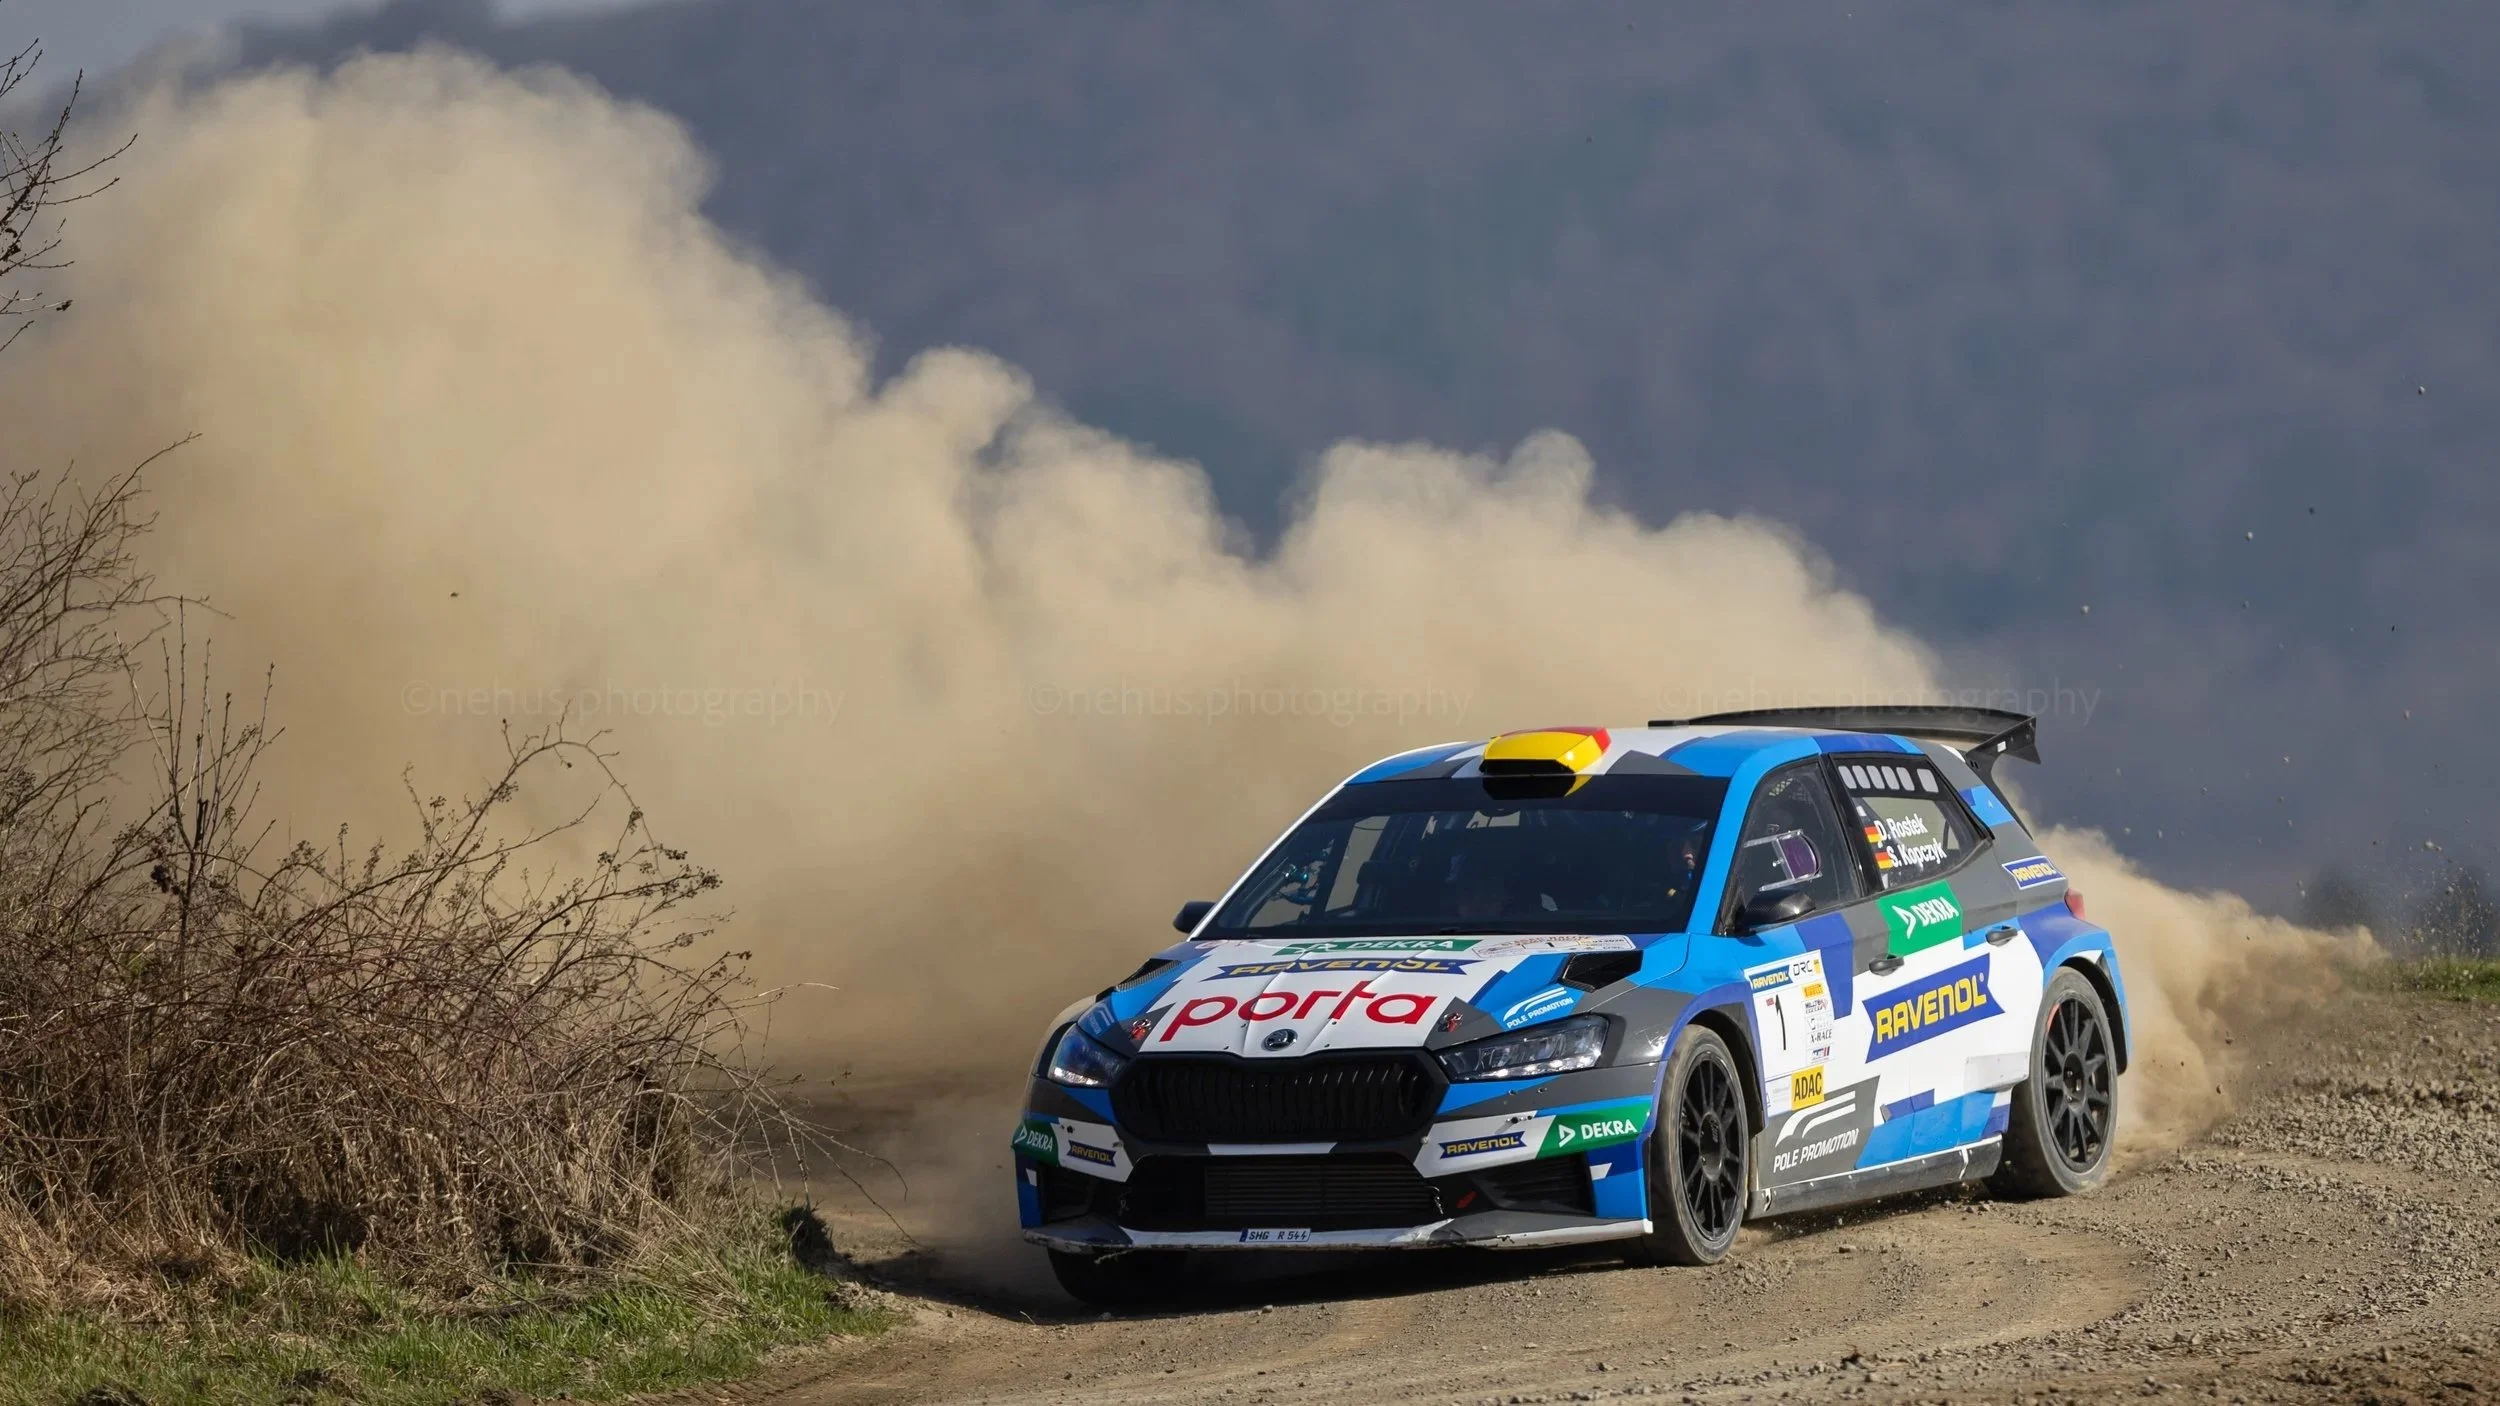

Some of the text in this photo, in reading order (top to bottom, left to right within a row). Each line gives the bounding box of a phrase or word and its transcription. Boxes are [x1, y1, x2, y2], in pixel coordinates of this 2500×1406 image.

[1873, 813, 1928, 841] D. Rostek
[1887, 838, 1948, 867] S. Kopczyk
[2011, 863, 2057, 881] RAVENOL
[1910, 897, 1959, 926] DEKRA
[1355, 940, 1455, 950] DEKRA
[1229, 958, 1451, 976] RAVENOL
[1752, 971, 1788, 989] RAVENOL
[1159, 980, 1438, 1042] porta
[1507, 997, 1574, 1028] POLE PROMOTION
[1775, 994, 1786, 1050] 1
[1876, 975, 1987, 1044] RAVENOL
[1794, 1072, 1822, 1101] ADAC
[1026, 1130, 1053, 1152] DEKRA
[1581, 1119, 1637, 1139] DEKRA
[1071, 1145, 1112, 1162] RAVENOL
[1446, 1136, 1518, 1154] RAVENOL
[1773, 1128, 1859, 1173] POLE PROMOTION
[1249, 1231, 1307, 1240] SHG R 544
